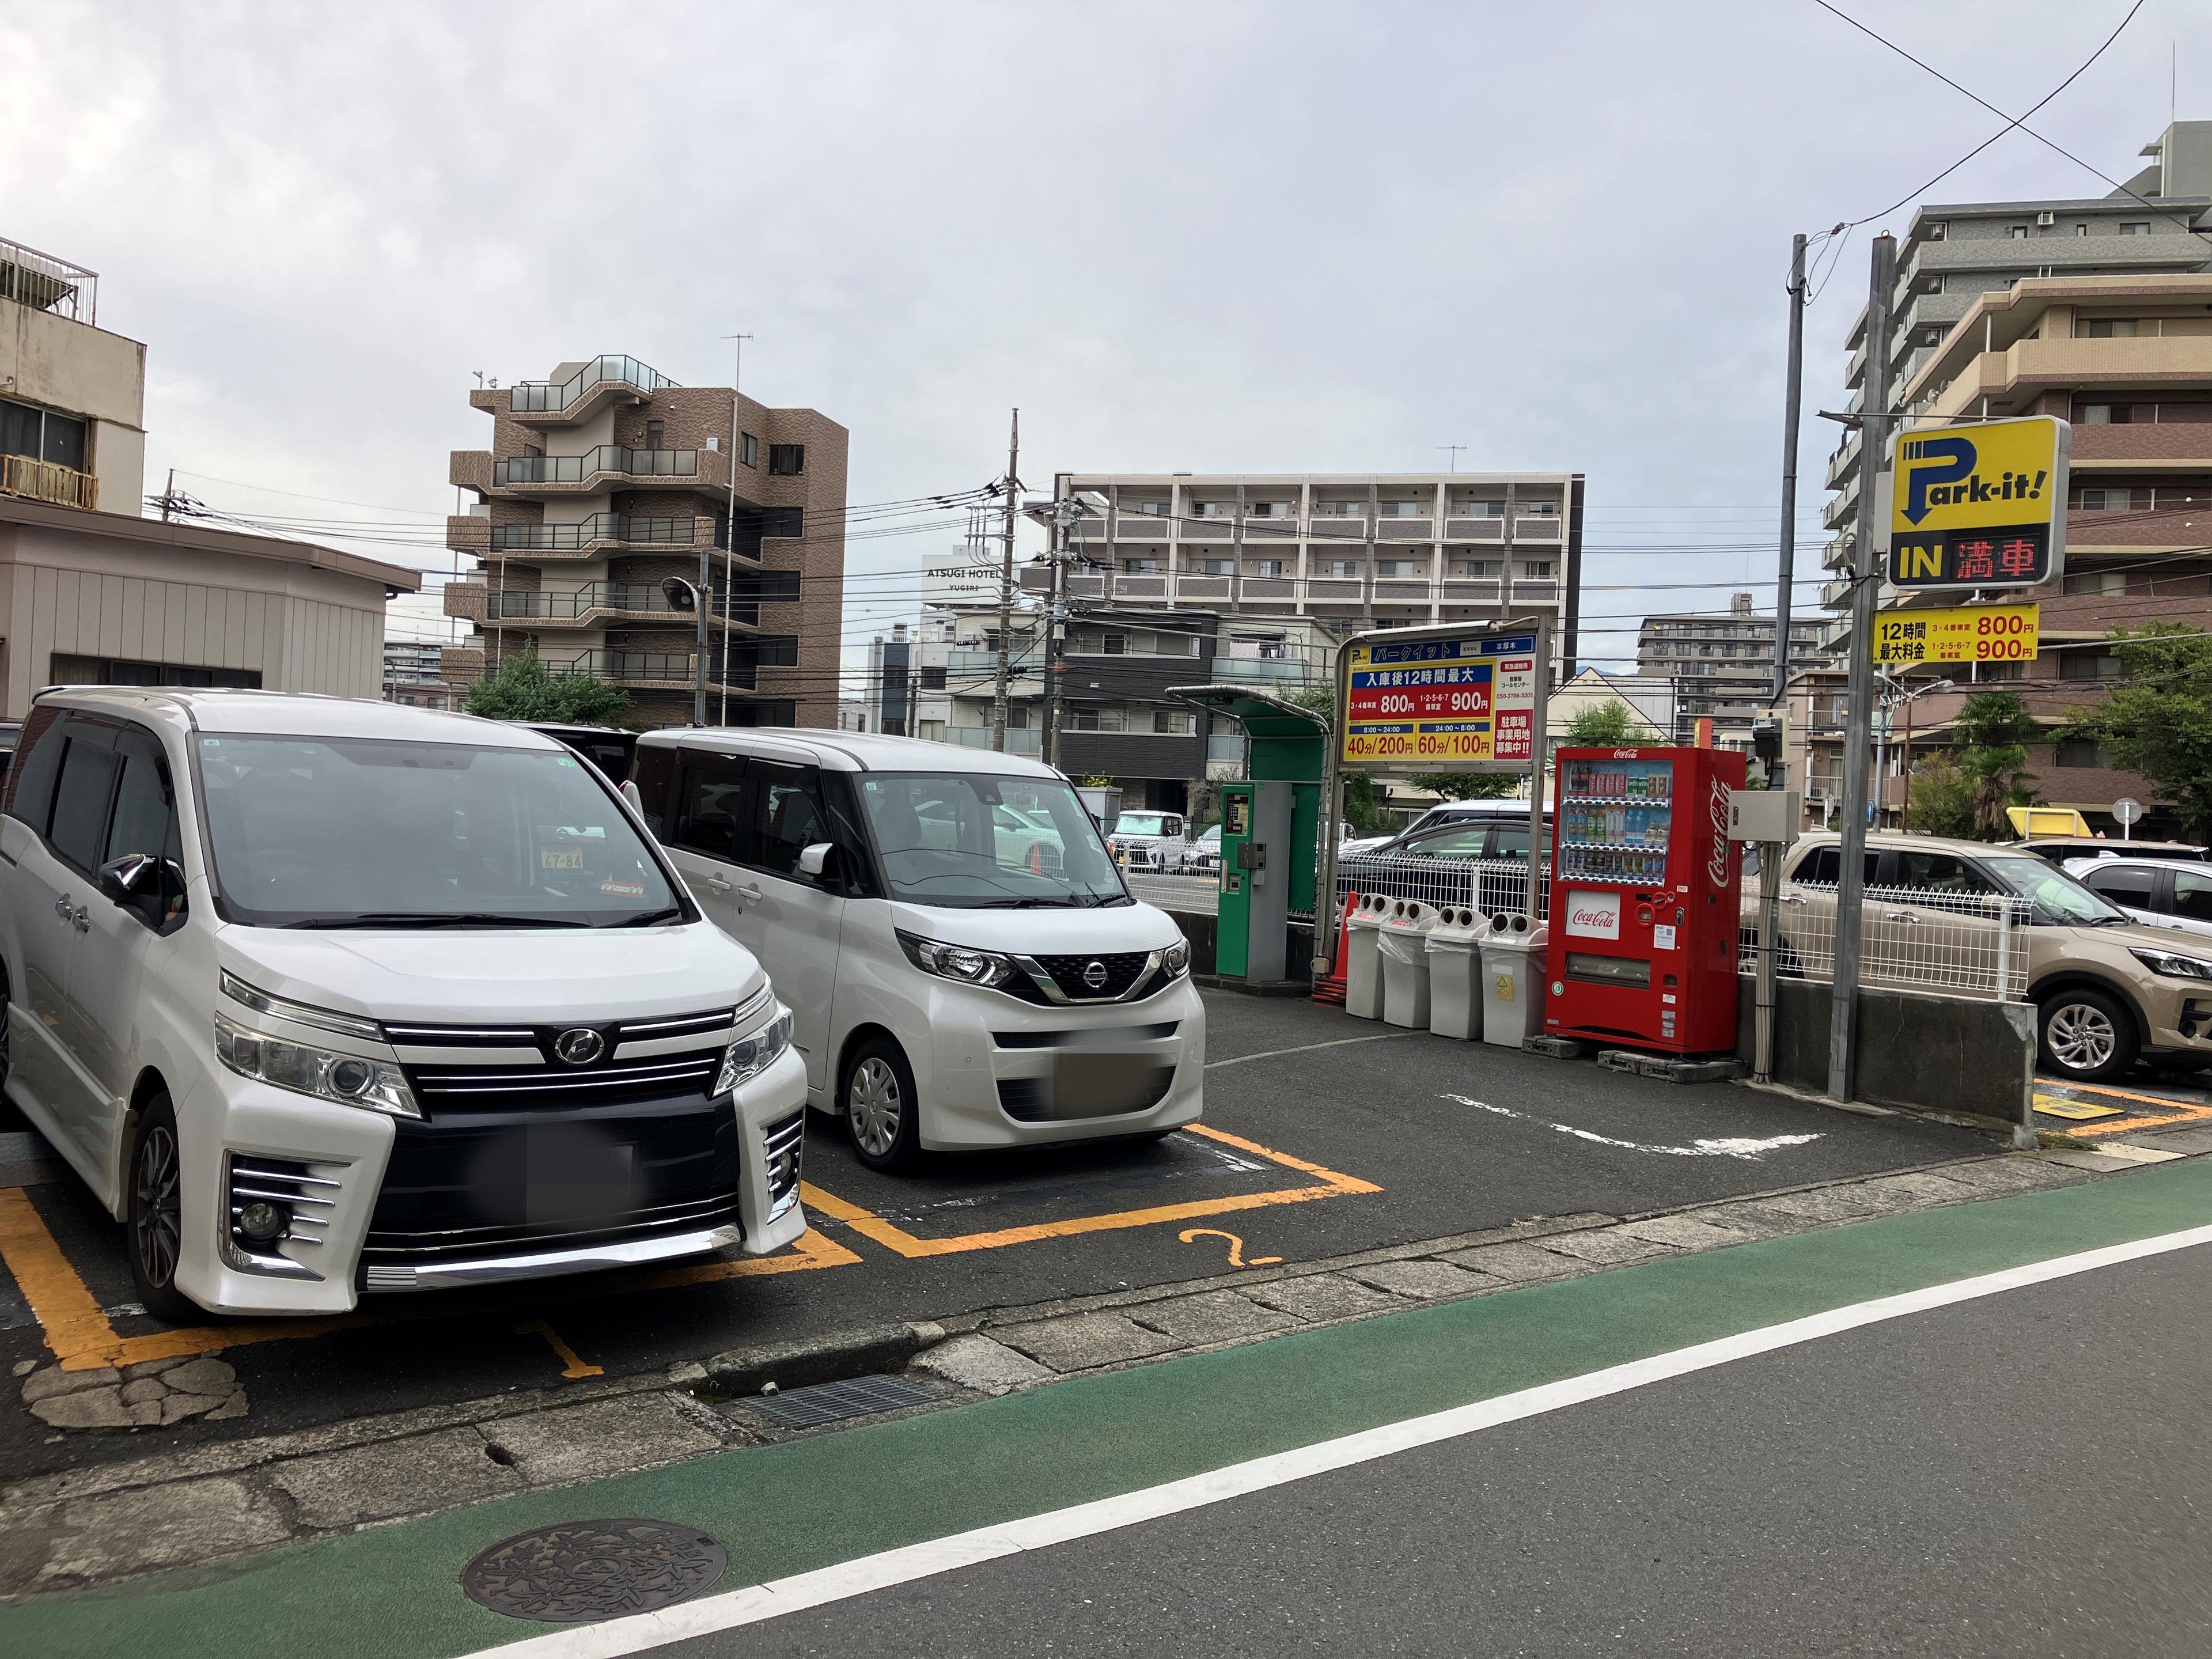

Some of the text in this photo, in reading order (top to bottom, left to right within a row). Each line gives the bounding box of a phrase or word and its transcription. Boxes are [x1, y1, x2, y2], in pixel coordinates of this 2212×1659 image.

[1900, 437, 2047, 526] Park-it!
[1899, 544, 1942, 579] IN
[1957, 539, 2035, 578] 満車
[927, 569, 1001, 578] ATSUGI HOTEL
[1881, 622, 1926, 641] 12時間
[1978, 615, 2033, 635] 800円
[1374, 643, 1450, 661] パークイット
[1496, 642, 1516, 650] 本厚木
[1880, 642, 1925, 660] 最大料金
[1976, 639, 2032, 659] 900円
[1366, 667, 1474, 687] 入庫後12時間最大
[1381, 695, 1415, 713] 800円
[1451, 691, 1488, 711] 900円
[1501, 715, 1527, 728] 駐車場
[1497, 729, 1530, 741] 事業用地
[1179, 1228, 1283, 1267] 2
